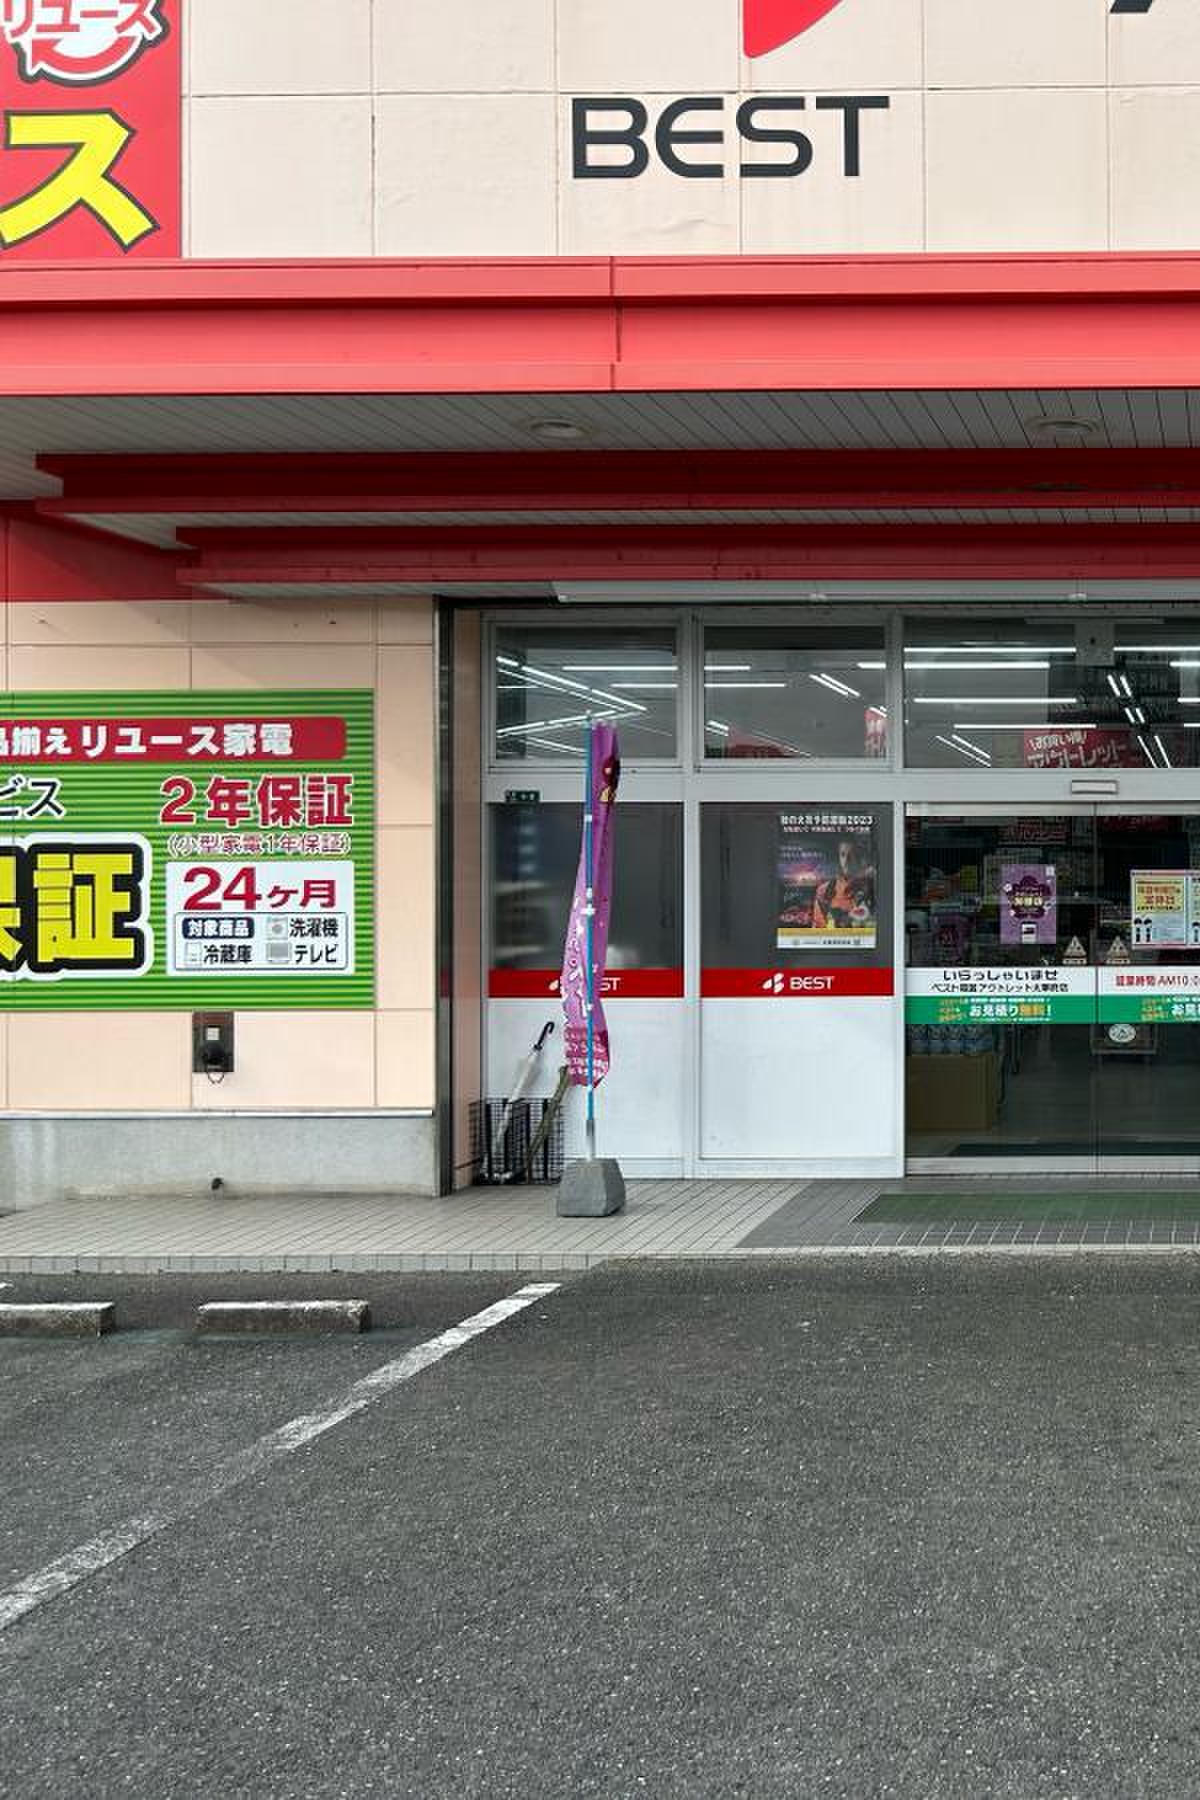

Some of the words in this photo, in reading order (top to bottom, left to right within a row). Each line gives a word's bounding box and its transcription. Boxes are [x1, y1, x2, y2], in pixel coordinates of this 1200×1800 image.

[571, 95, 890, 179] BEST
[160, 776, 353, 827] 2年保証
[0, 853, 136, 963] 証
[188, 919, 250, 938] 対象商品
[289, 918, 339, 938] 洗濯機
[203, 943, 253, 963] 冷蔵庫
[294, 943, 338, 963] テレビ
[789, 975, 836, 990] BEST
[943, 969, 1058, 981] いらっしゃいませ
